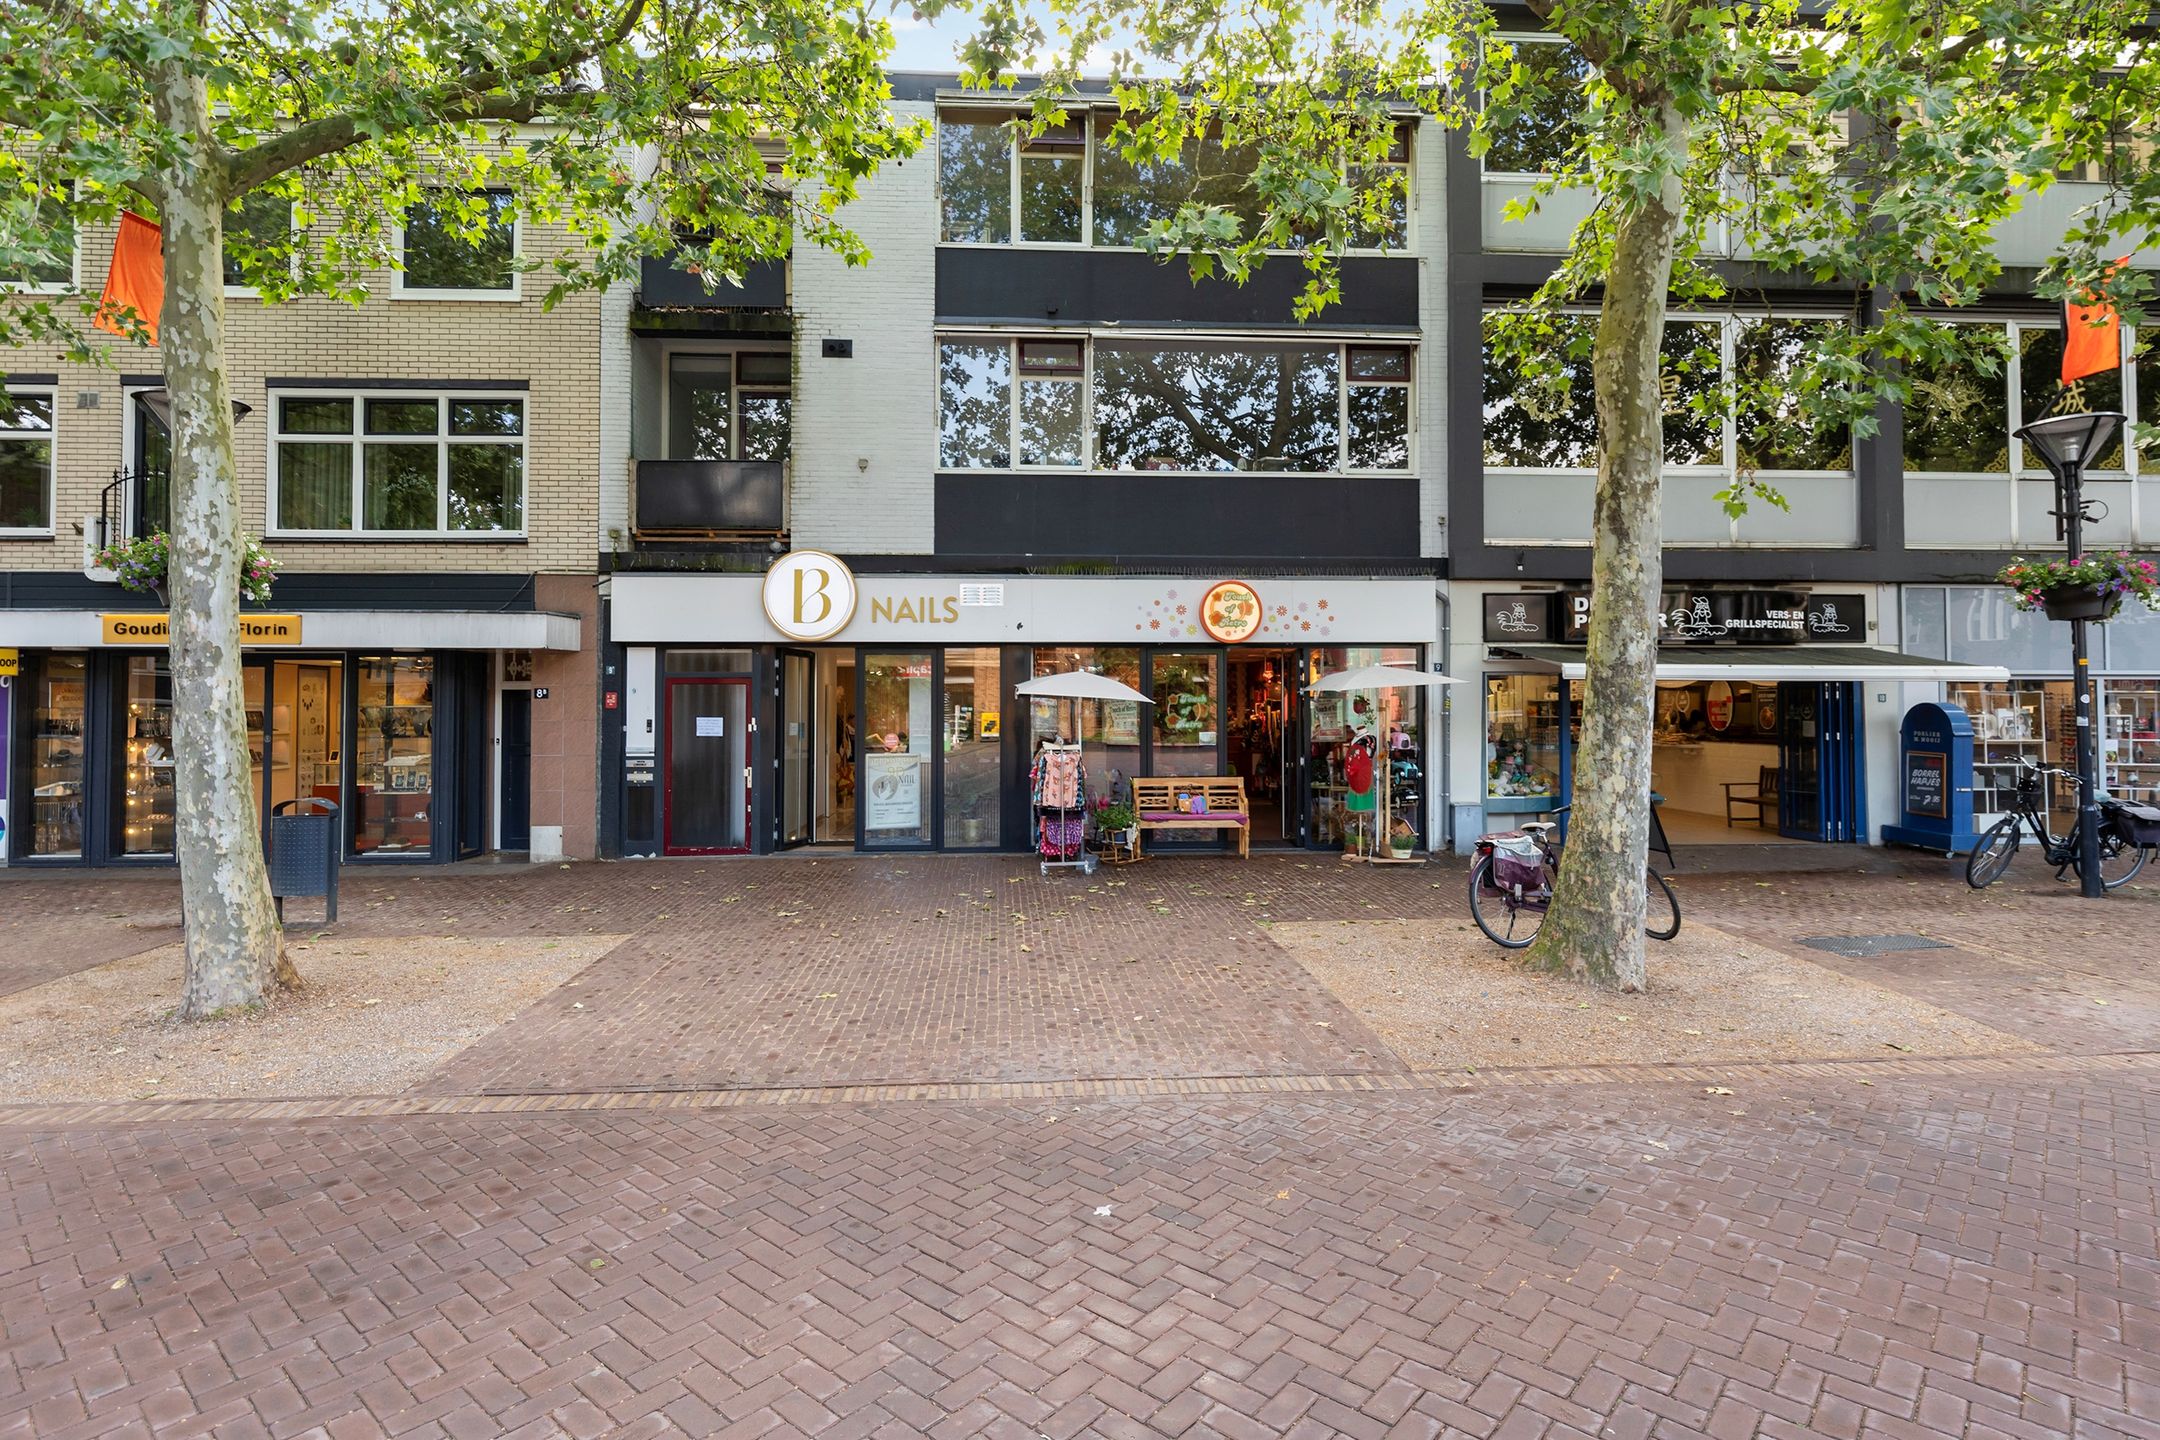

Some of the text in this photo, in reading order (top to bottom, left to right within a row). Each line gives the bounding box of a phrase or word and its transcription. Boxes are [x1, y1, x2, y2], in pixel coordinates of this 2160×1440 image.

[2051, 378, 2093, 416] 城
[792, 568, 959, 624] B NAILS
[1766, 610, 1804, 619] VERS- EN
[1725, 619, 1804, 629] GRILLSPECIALIST
[1912, 769, 1940, 778] BORREL
